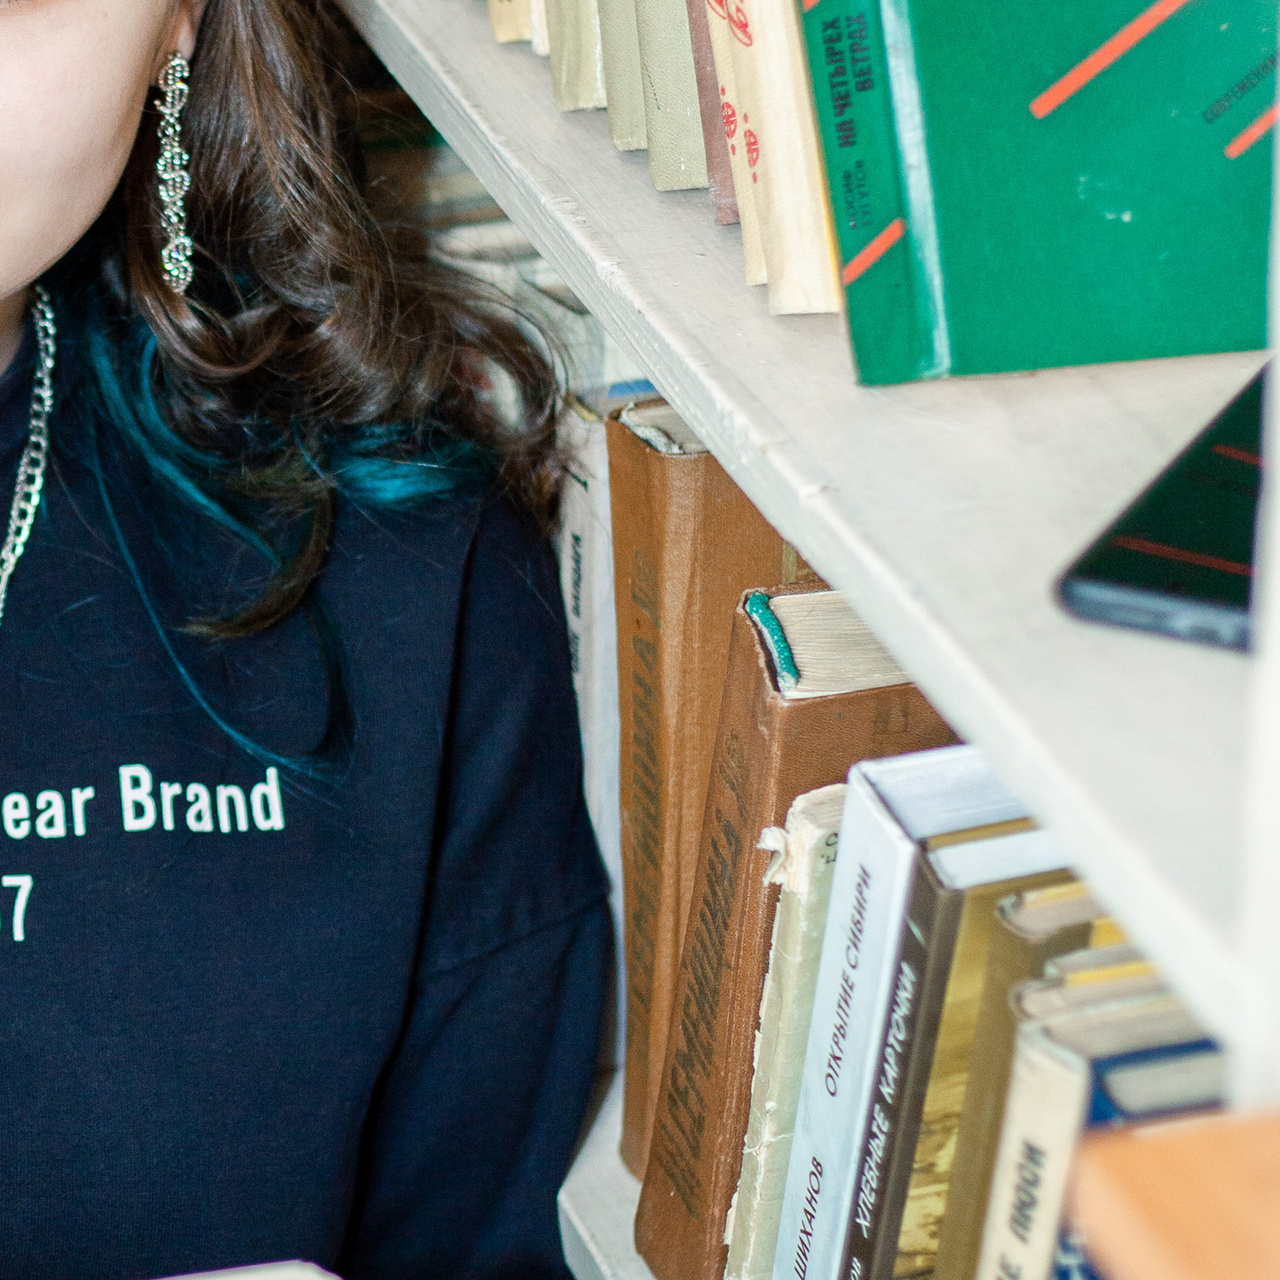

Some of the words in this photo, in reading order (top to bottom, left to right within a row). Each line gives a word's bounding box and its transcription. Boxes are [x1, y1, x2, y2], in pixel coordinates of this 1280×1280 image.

[821, 17, 852, 118] ЧЕТЫРЕХ
[845, 12, 875, 93] ВЕТРАХ
[118, 763, 286, 834] Brand
[791, 1153, 826, 1280] ШИХАНОВ
[824, 969, 858, 1098] ОТКРЫТИЕ
[844, 863, 875, 966] СИБИРИ
[853, 1108, 893, 1240] ХЛЕБНЫЕ
[880, 963, 919, 1106] КАРТОЧКИ
